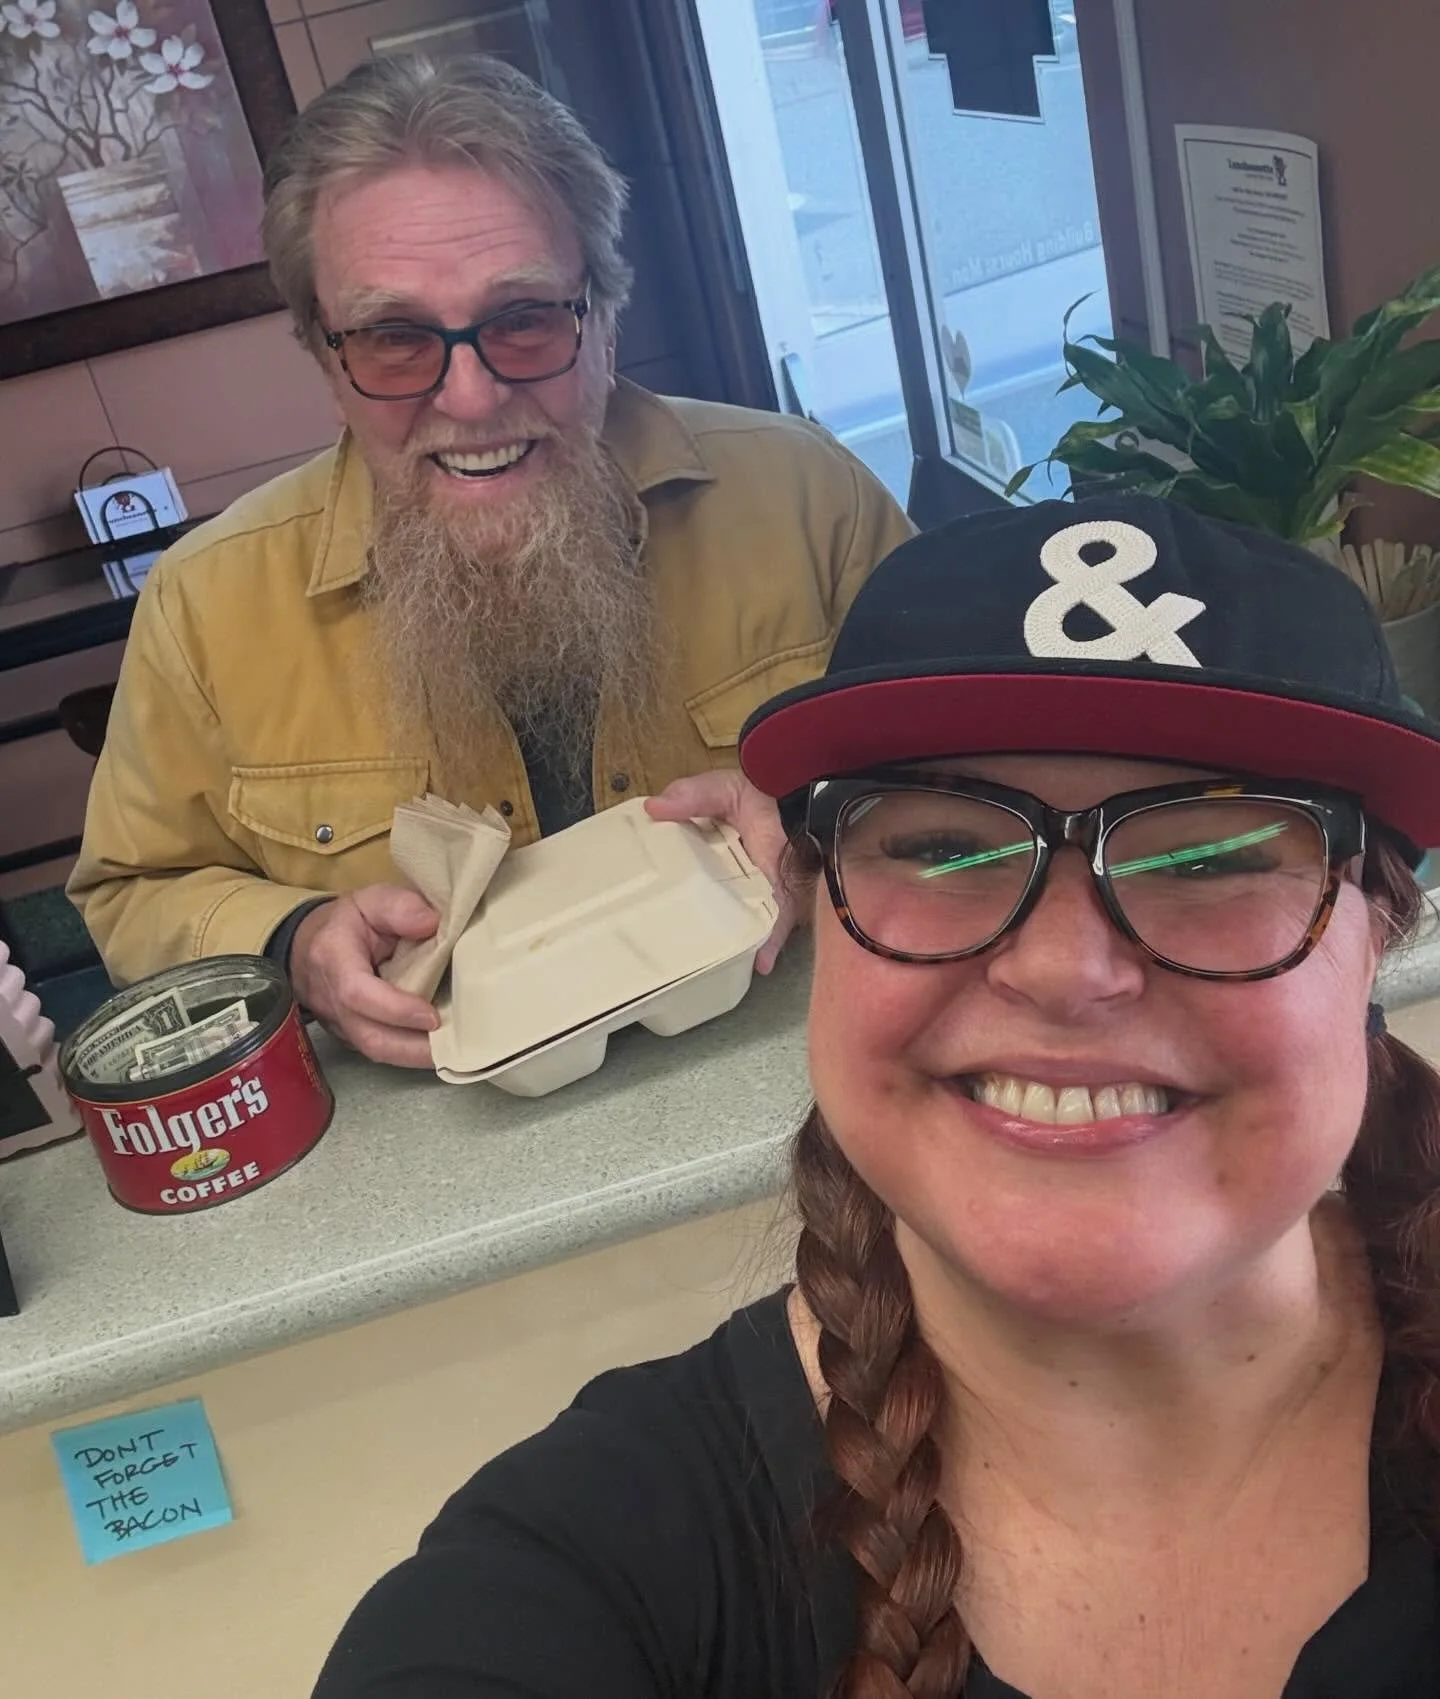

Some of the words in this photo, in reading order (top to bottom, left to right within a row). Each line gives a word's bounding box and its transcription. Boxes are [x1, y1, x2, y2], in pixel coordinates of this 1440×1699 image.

[1024, 520, 1206, 669] &
[99, 1024, 142, 1056] AMERICA
[93, 1075, 269, 1156] Folger's
[160, 1161, 260, 1204] COFFEE
[74, 1429, 164, 1468] DONT
[93, 1443, 198, 1488] FORGET
[85, 1486, 149, 1520] THE
[104, 1498, 202, 1541] BACON
